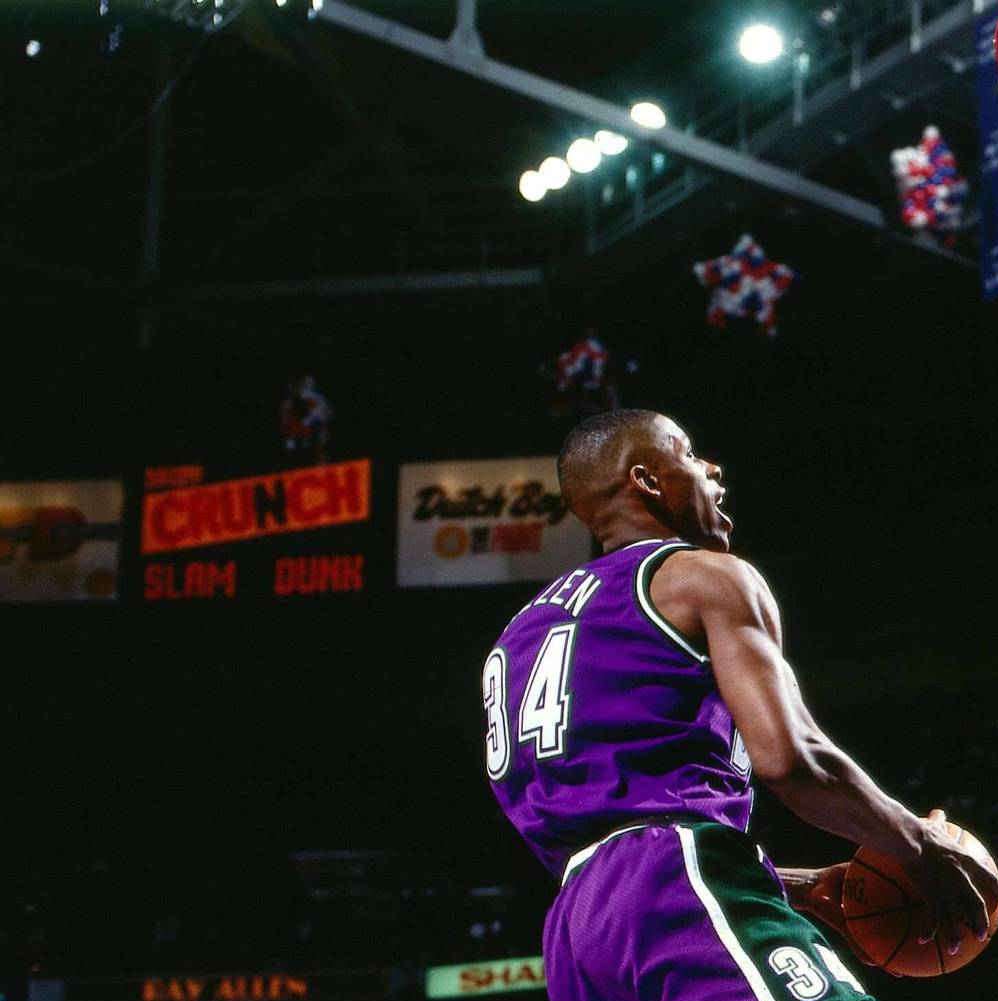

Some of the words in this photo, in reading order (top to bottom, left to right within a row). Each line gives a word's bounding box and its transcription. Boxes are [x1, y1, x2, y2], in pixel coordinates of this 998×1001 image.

[153, 467, 360, 545] CRUNCH
[144, 561, 237, 598] SLAM
[274, 555, 364, 595] DUNK
[482, 622, 578, 782] 34
[216, 974, 308, 1001] ALLEN
[459, 964, 545, 993] SHA
